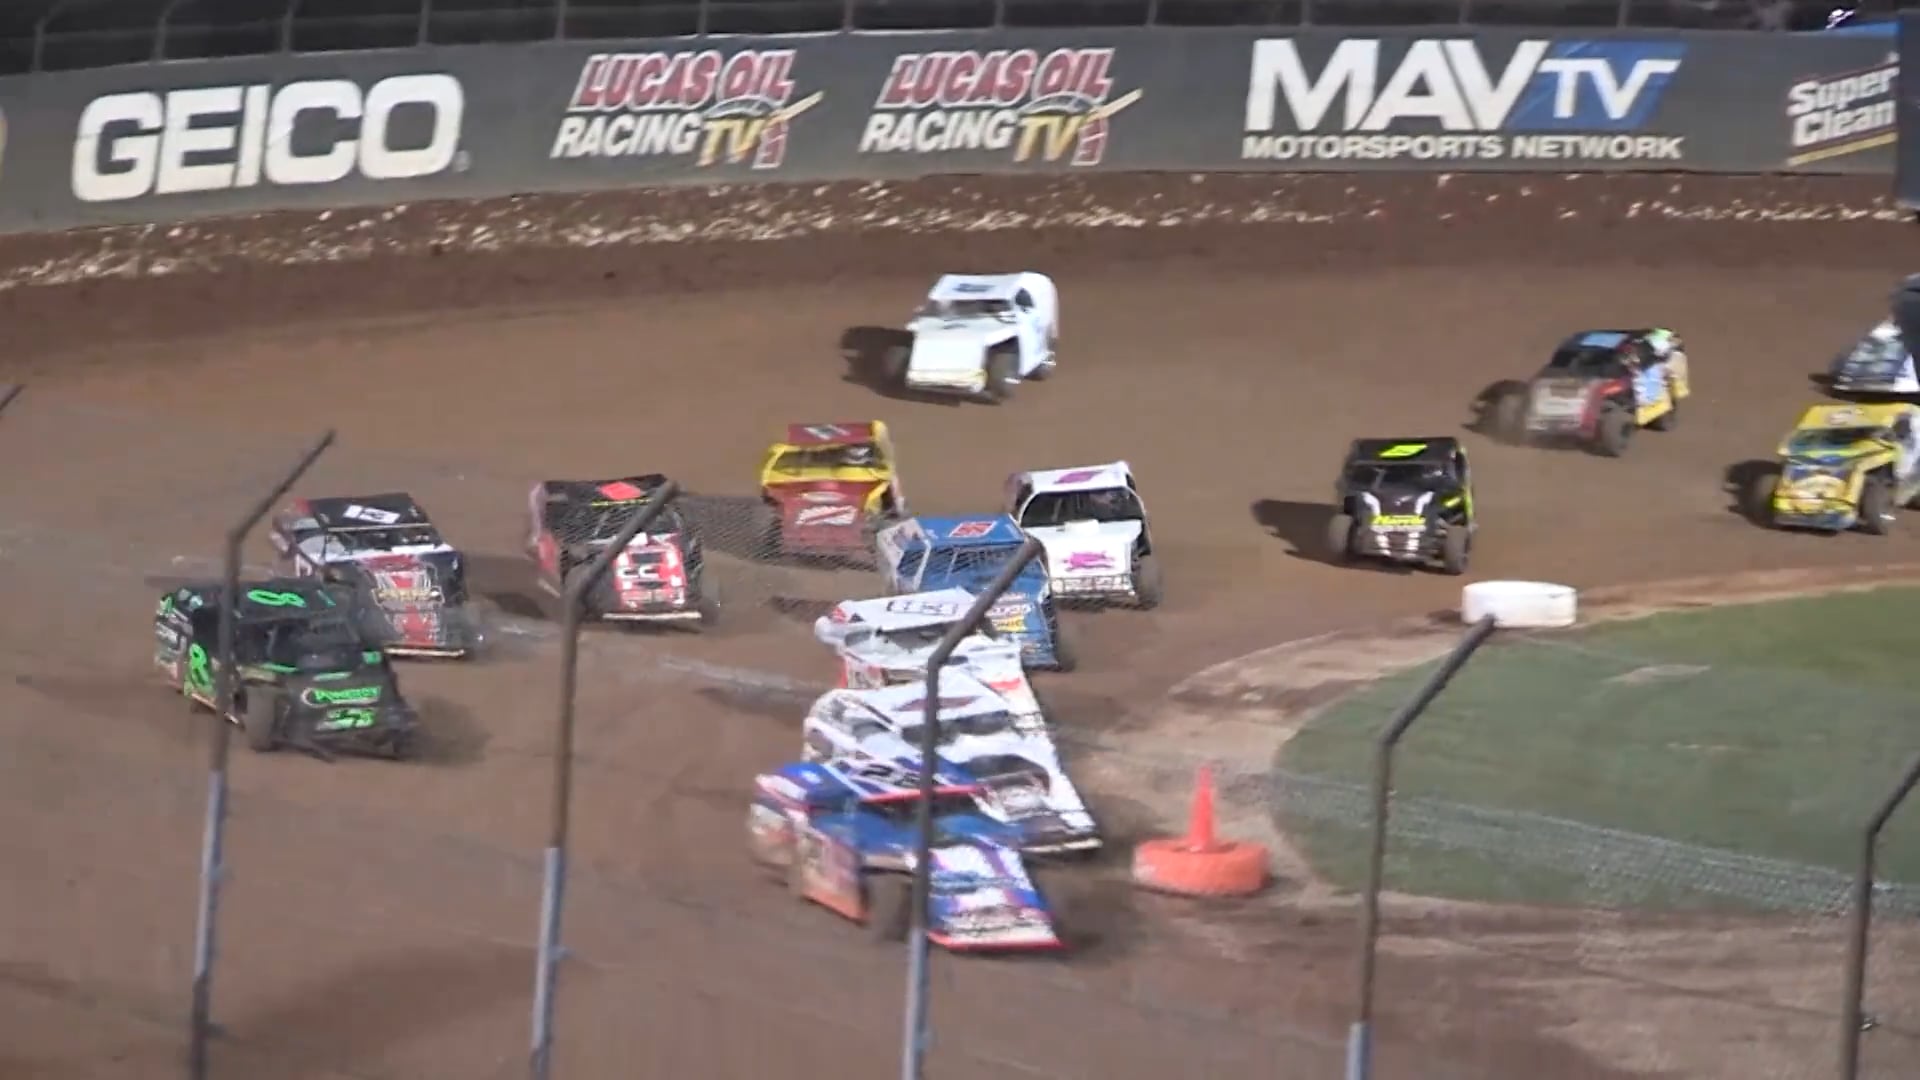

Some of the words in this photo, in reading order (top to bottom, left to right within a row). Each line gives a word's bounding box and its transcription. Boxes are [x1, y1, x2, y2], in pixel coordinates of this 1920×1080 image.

[566, 50, 722, 112] LUCAS
[715, 49, 797, 106] OIL
[874, 49, 1038, 109] LUCAS
[1031, 47, 1116, 104] OIL
[1785, 66, 1900, 117] Super
[72, 74, 464, 202] GEICO
[550, 112, 700, 158] RACING
[858, 109, 1017, 152] RACING
[1241, 133, 1504, 160] MOTORSPORTS
[1511, 133, 1685, 160] NETWORK
[1792, 99, 1897, 148] Clean
[246, 589, 307, 608] 8
